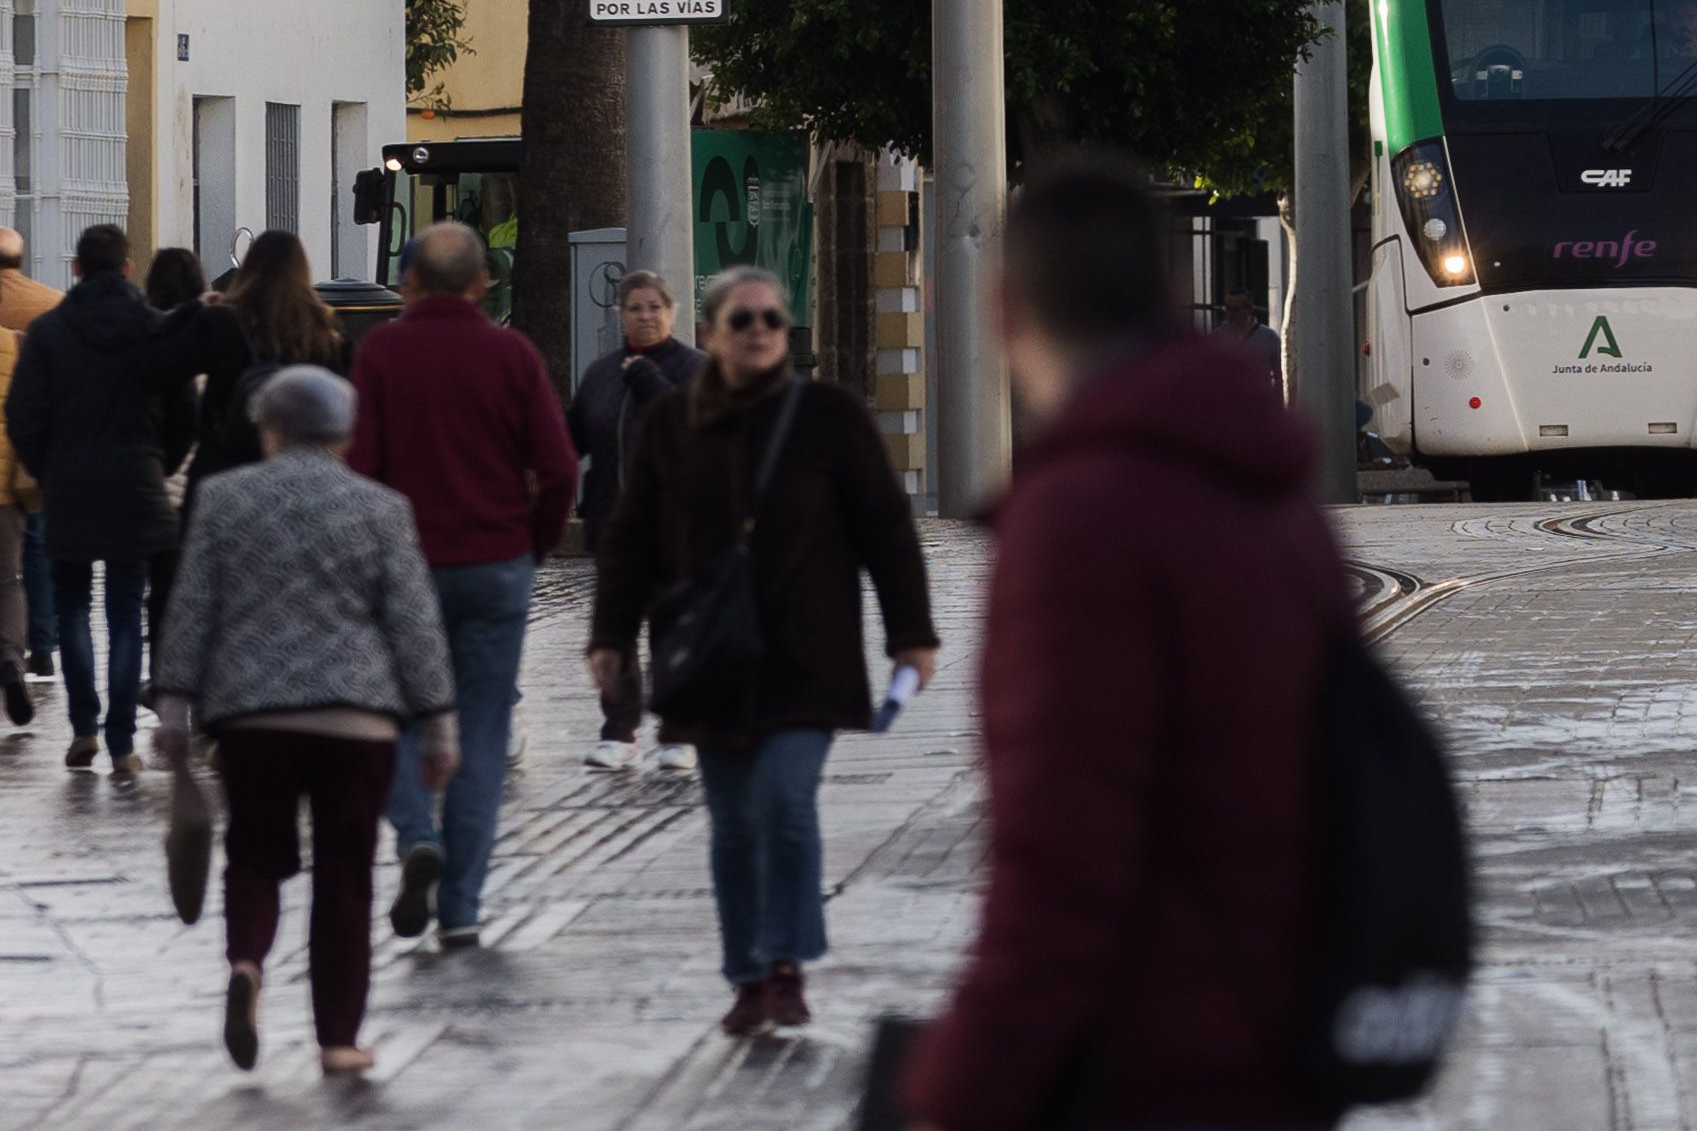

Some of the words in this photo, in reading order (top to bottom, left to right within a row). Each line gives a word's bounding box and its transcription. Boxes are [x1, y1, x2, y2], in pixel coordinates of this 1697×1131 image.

[596, 1, 630, 15] POR
[637, 1, 670, 14] LAS
[1581, 169, 1632, 187] CAF
[1553, 230, 1657, 268] renfe
[1552, 364, 1582, 374] Junta
[1584, 364, 1598, 373] de
[1600, 362, 1652, 373] Andalucía
